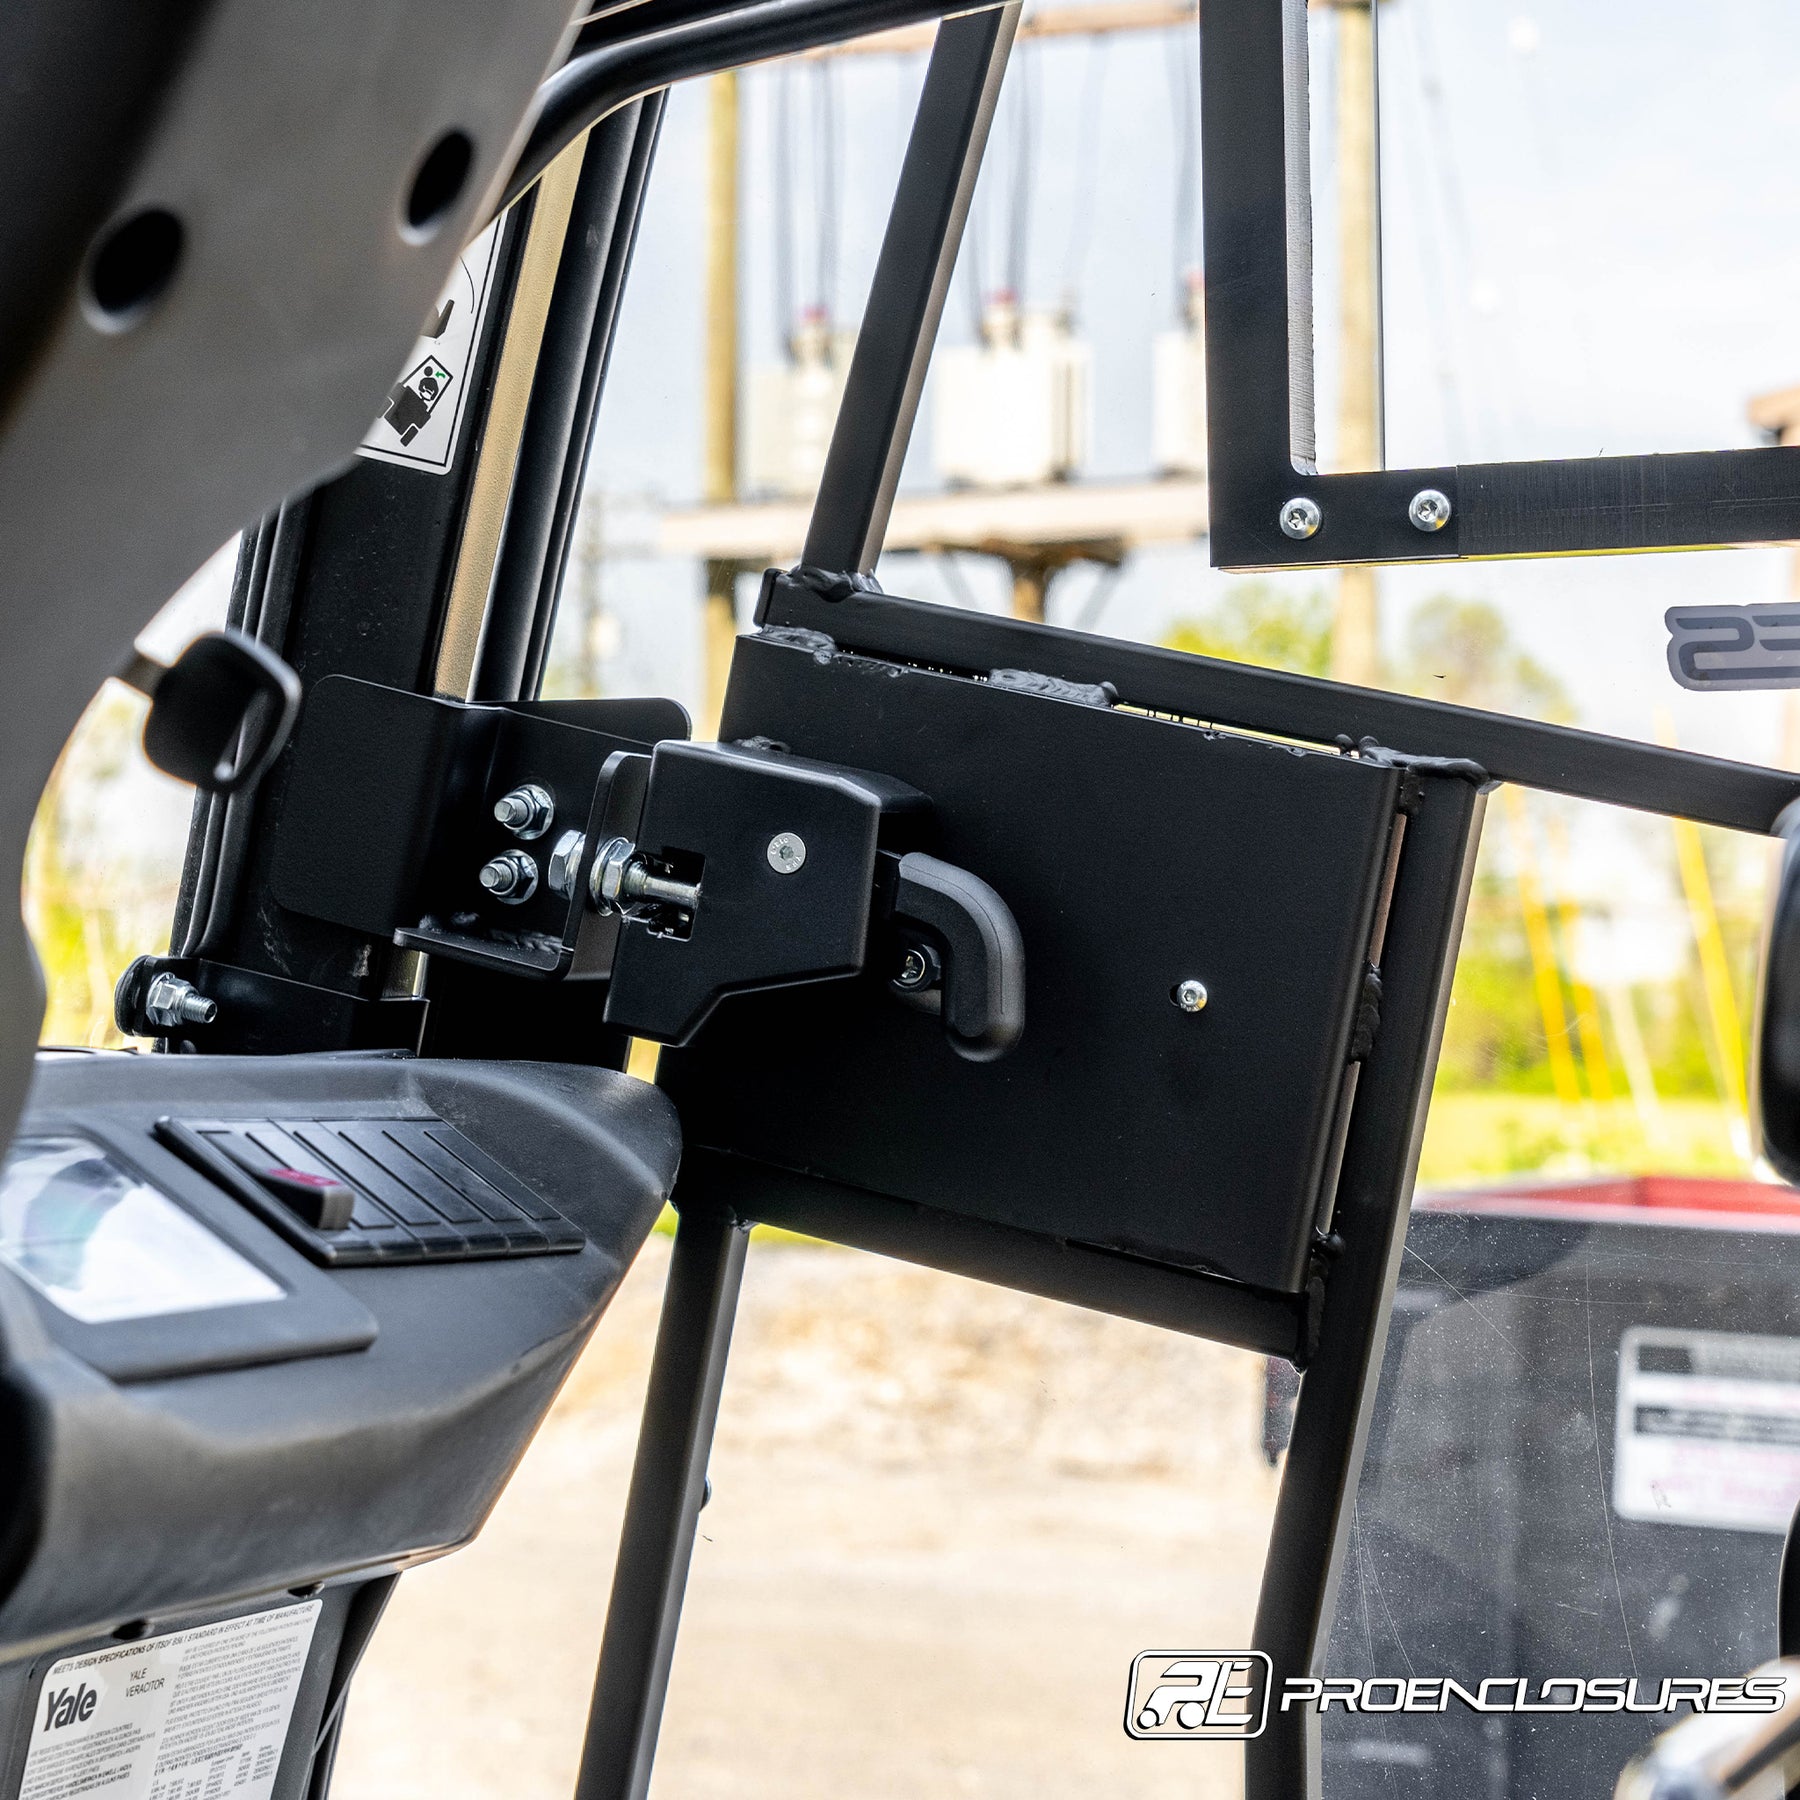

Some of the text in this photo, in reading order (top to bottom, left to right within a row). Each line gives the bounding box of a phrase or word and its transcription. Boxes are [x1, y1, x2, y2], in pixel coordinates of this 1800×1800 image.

[53, 1664, 75, 1675] MEETS
[74, 1657, 97, 1670] DESIGN
[97, 1646, 146, 1666] SPECIFICATIONS
[145, 1643, 156, 1653] OF
[187, 1627, 216, 1642] STANDARD
[224, 1620, 246, 1633] EFFECT
[253, 1615, 267, 1625] TIME
[274, 1604, 315, 1620] MANUFACTURE
[125, 1677, 165, 1698] VERACITOR
[130, 1667, 148, 1681] YALE
[44, 1682, 98, 1732] Yale
